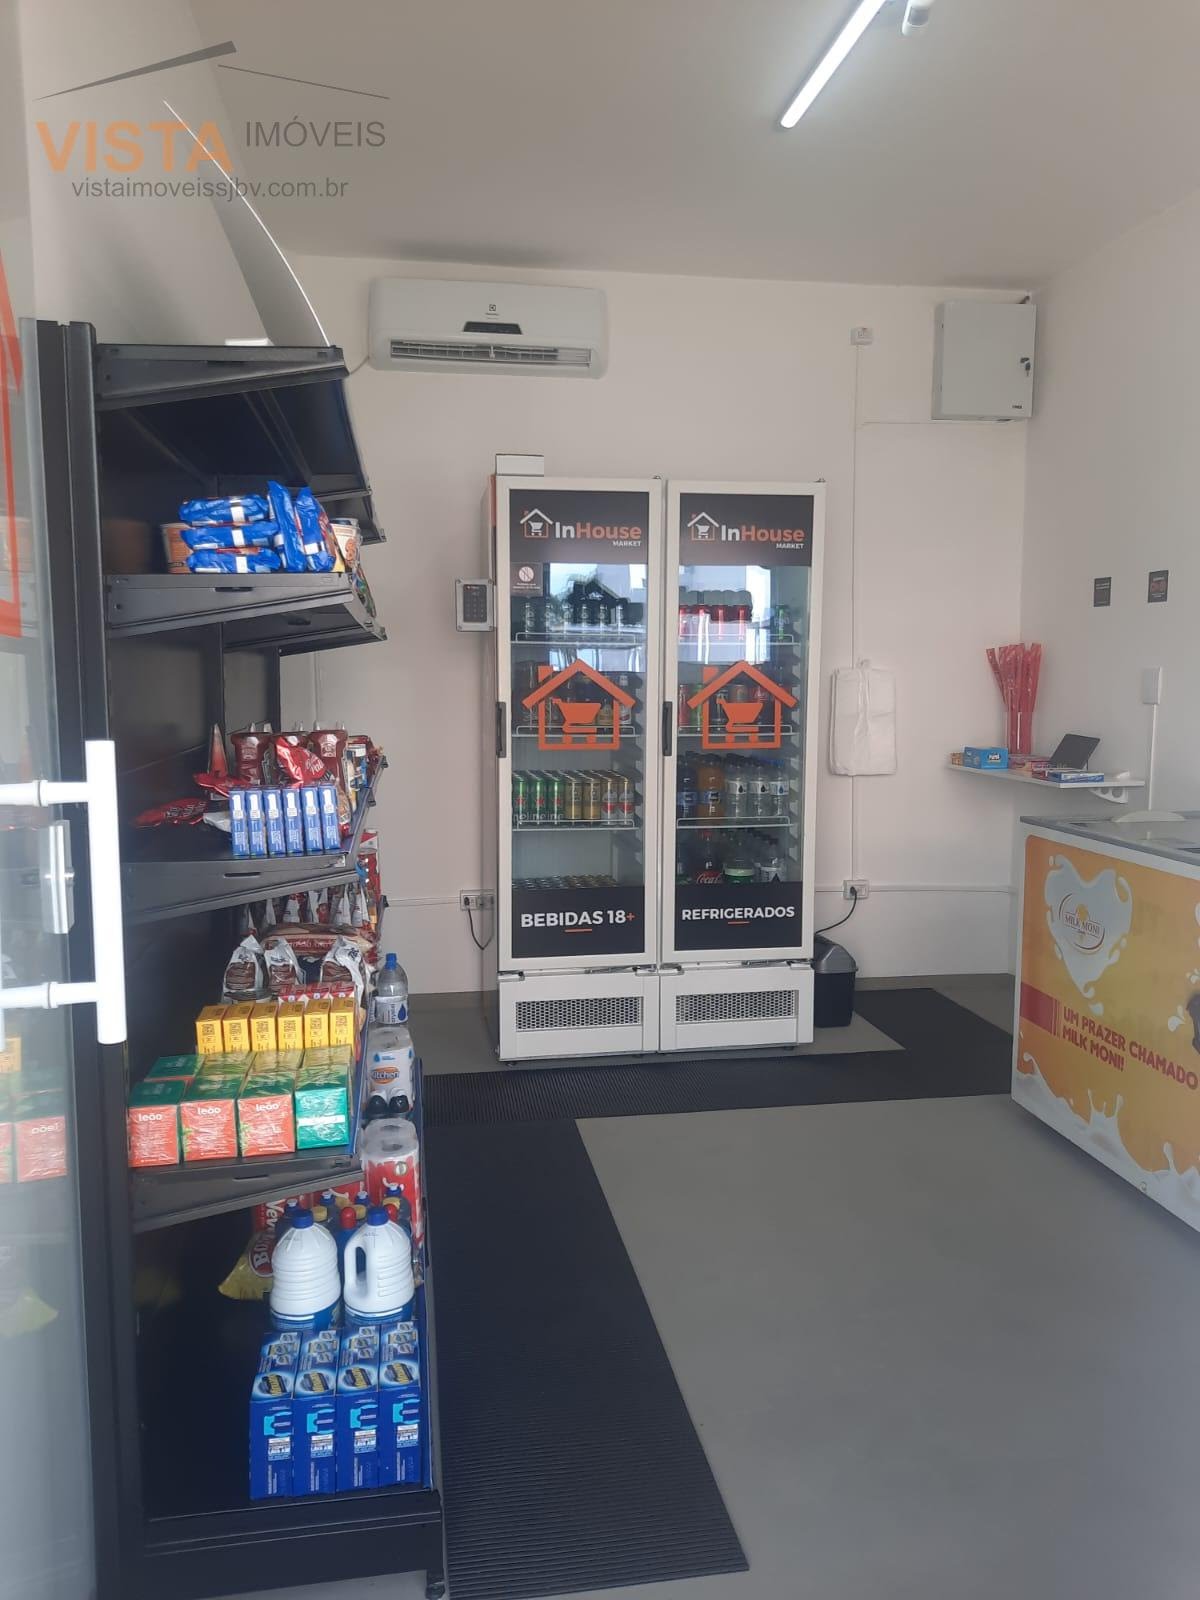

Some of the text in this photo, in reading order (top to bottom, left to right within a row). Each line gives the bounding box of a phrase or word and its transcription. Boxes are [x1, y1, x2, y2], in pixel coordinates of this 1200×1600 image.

[555, 522, 642, 539] InHouse
[721, 525, 805, 541] InHouse
[521, 909, 636, 927] BEBIDAS 18+
[682, 906, 796, 920] REFRIGERADOS
[1062, 1006, 1199, 1090] UM PRAZER CHAMADO
[1062, 1025, 1125, 1072] MILK MONI!
